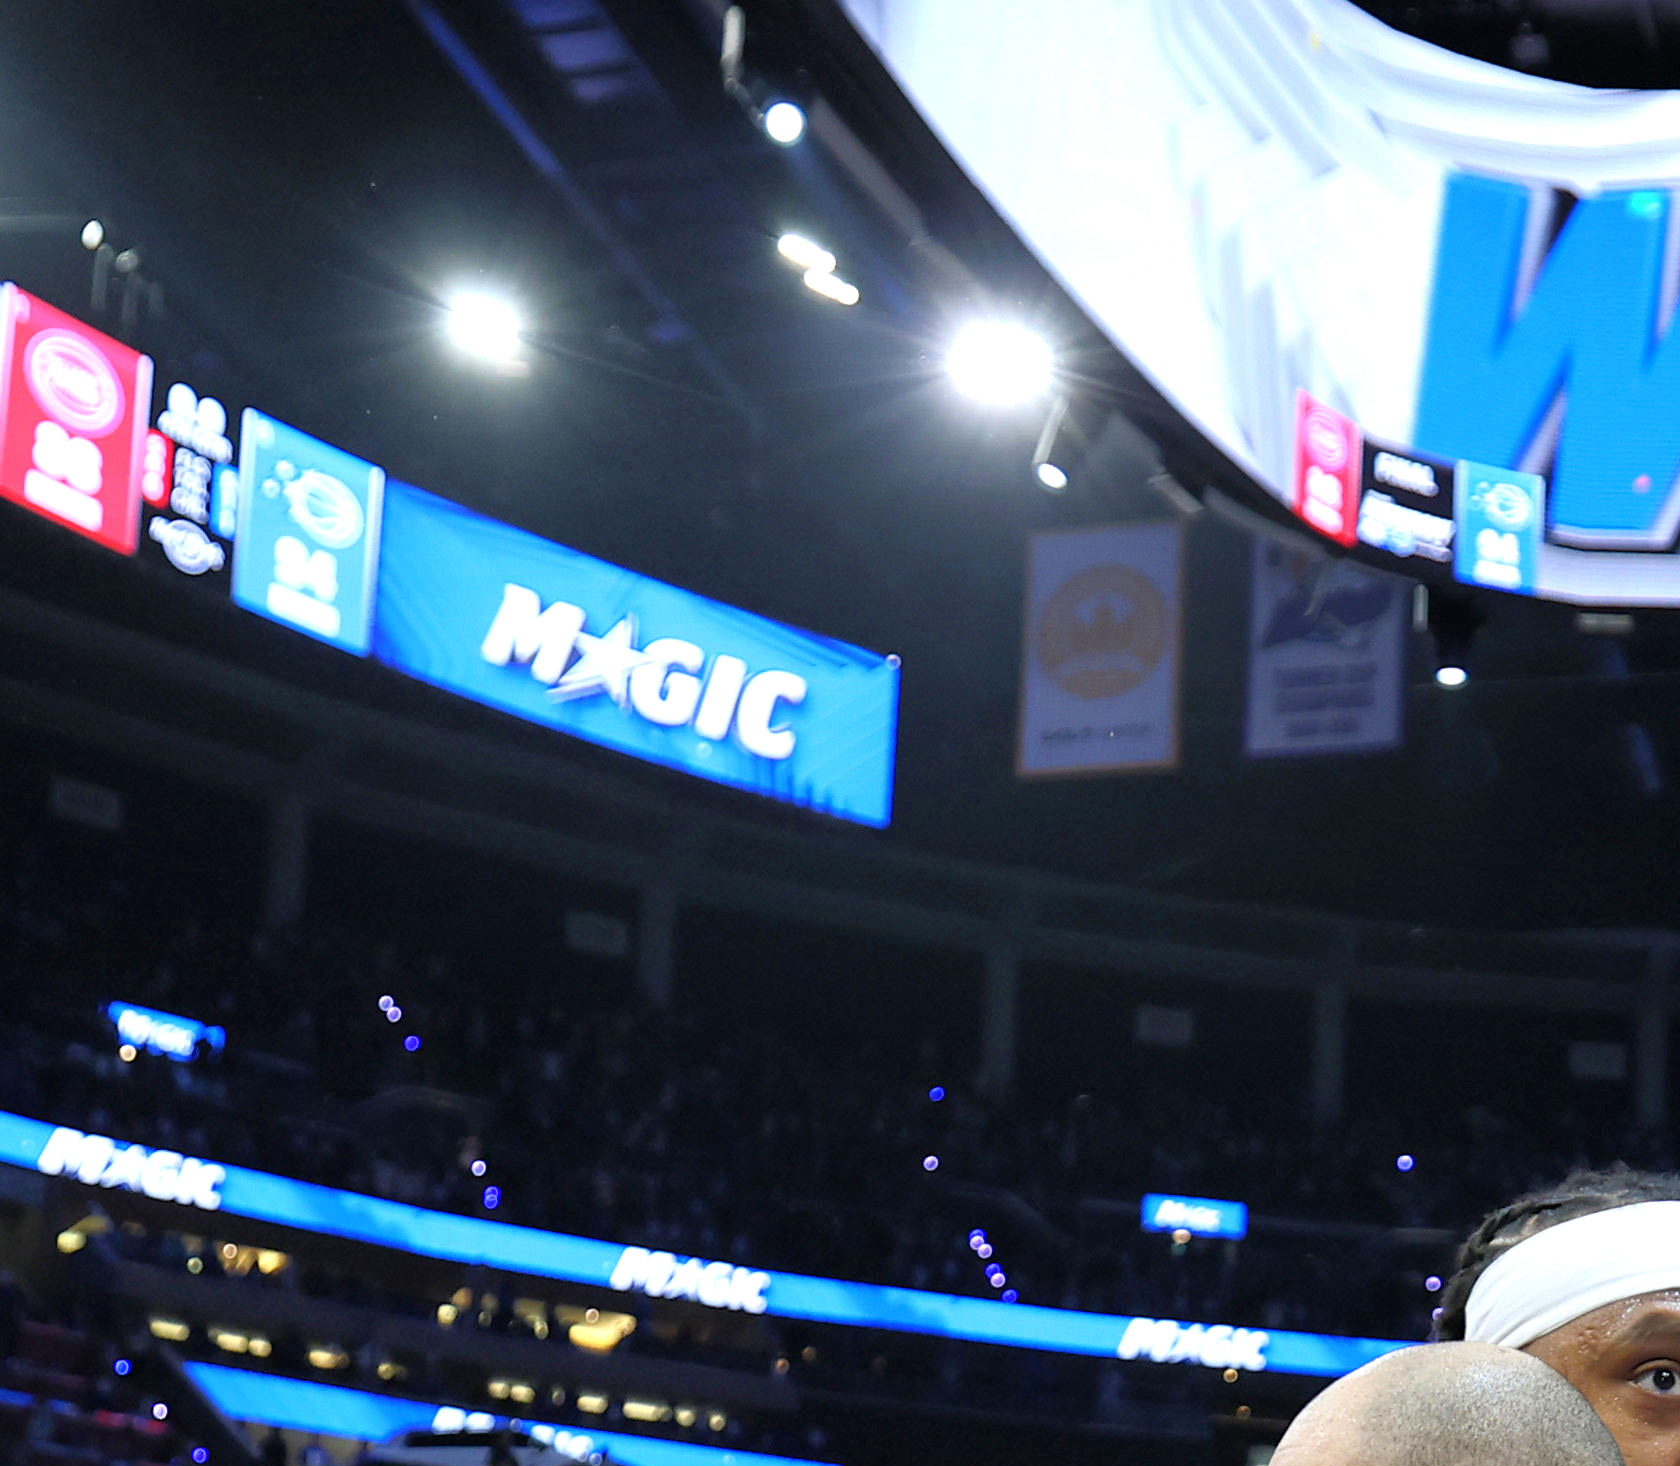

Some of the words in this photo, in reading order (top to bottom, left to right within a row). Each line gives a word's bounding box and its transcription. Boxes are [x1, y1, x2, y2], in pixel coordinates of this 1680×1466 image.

[481, 583, 806, 760] MAGIC
[37, 1127, 226, 1211] MAGIC
[609, 1247, 770, 1314] MAGIC
